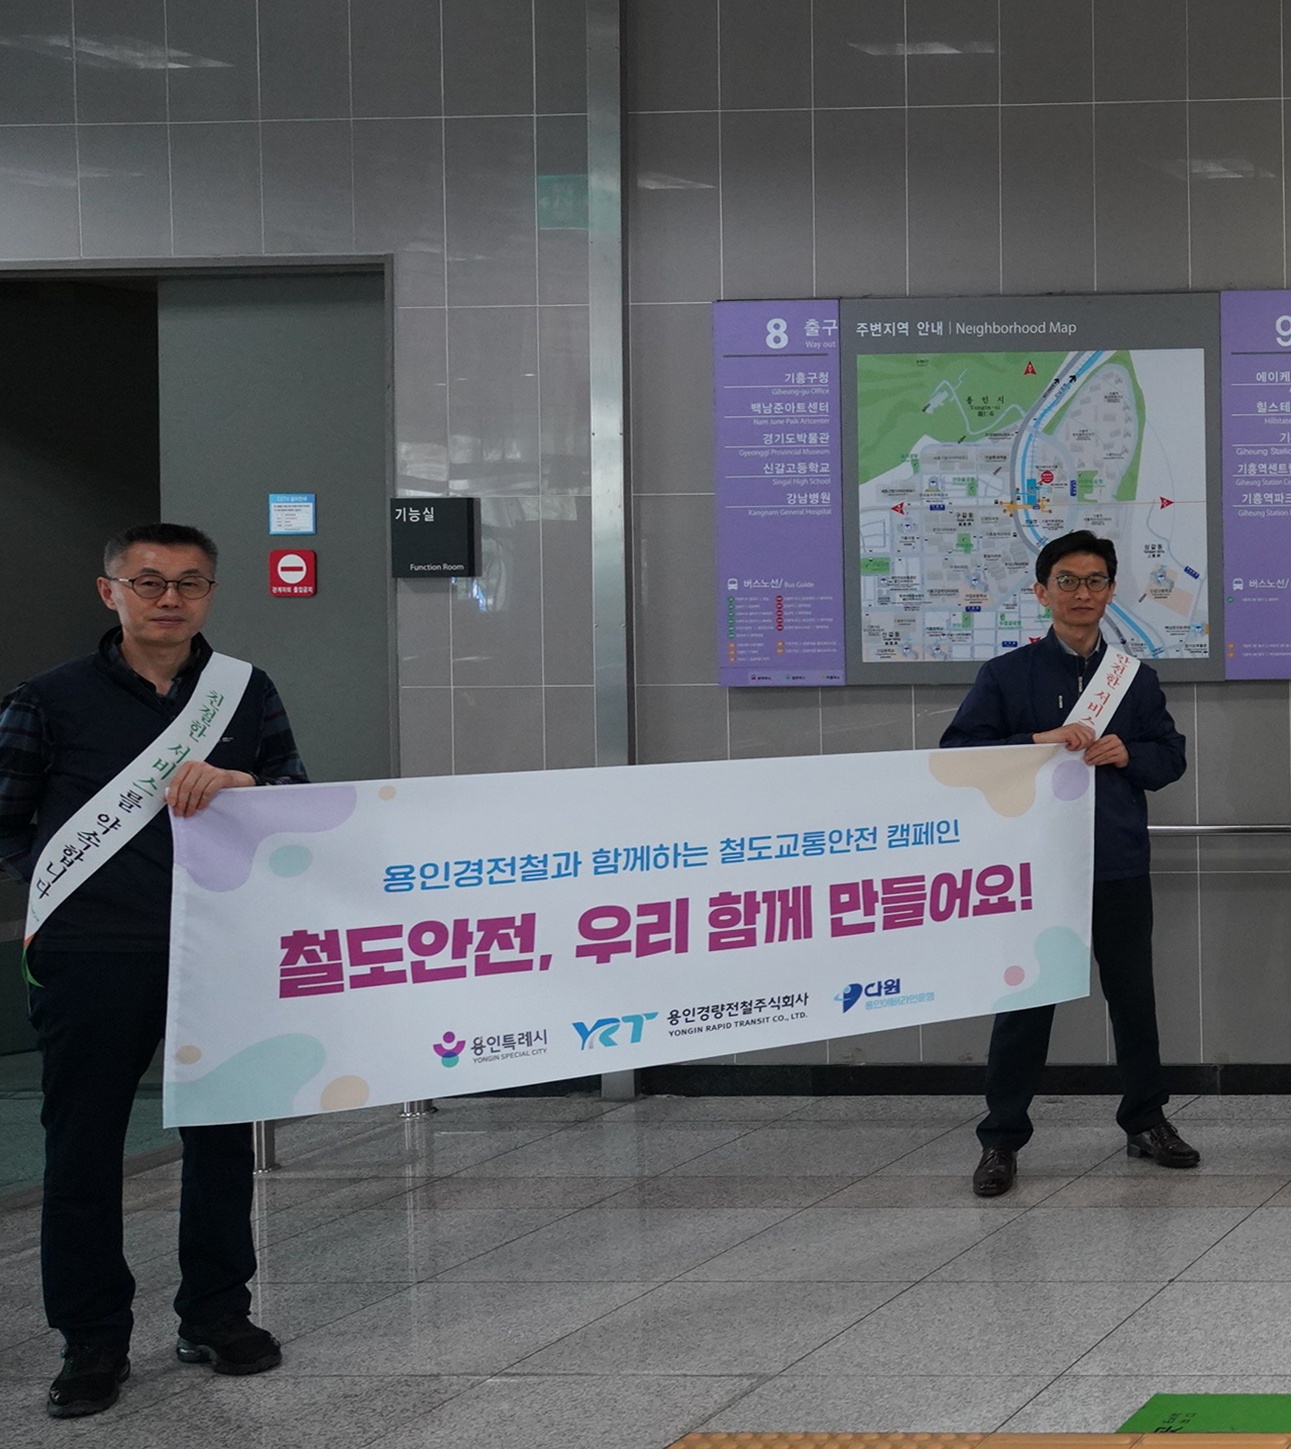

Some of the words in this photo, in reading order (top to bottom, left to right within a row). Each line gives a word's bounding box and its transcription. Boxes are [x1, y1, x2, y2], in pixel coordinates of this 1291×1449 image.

[765, 318, 789, 349] 8
[804, 319, 838, 336] 출구
[856, 322, 910, 337] 주변지역
[917, 321, 943, 336] 안내
[956, 321, 1046, 335] Neighborhood
[1049, 322, 1077, 335] Map
[805, 341, 821, 349] Way
[784, 372, 829, 384] 기흥구청
[751, 402, 829, 414] 백남준아트센터
[762, 433, 829, 445] 경기도박물관
[763, 462, 830, 474] 신갈고등학교
[786, 492, 830, 505] 강남병원
[395, 507, 435, 522] 기능실
[443, 563, 464, 571] Room
[189, 689, 224, 743] 친절한
[36, 811, 121, 900] 약속합니다
[382, 850, 583, 895] 용인경전철과
[591, 840, 709, 879] 함께하는
[718, 826, 878, 870] 철도교통안전
[886, 818, 960, 854] 캠페인
[279, 912, 553, 999] 철도안전,
[574, 896, 689, 966] 우리
[707, 882, 815, 953] 함께
[829, 863, 1034, 939] 만들어요!
[864, 978, 901, 998] 다원
[667, 992, 809, 1027] 용인경량전철주식회사
[571, 1011, 659, 1051] YRT
[668, 1027, 703, 1037] YONGIN
[705, 1024, 732, 1034] RAPID
[734, 1019, 771, 1030] TRANSIT
[791, 1012, 808, 1021] LTD.
[470, 1028, 548, 1056] 용인특례시
